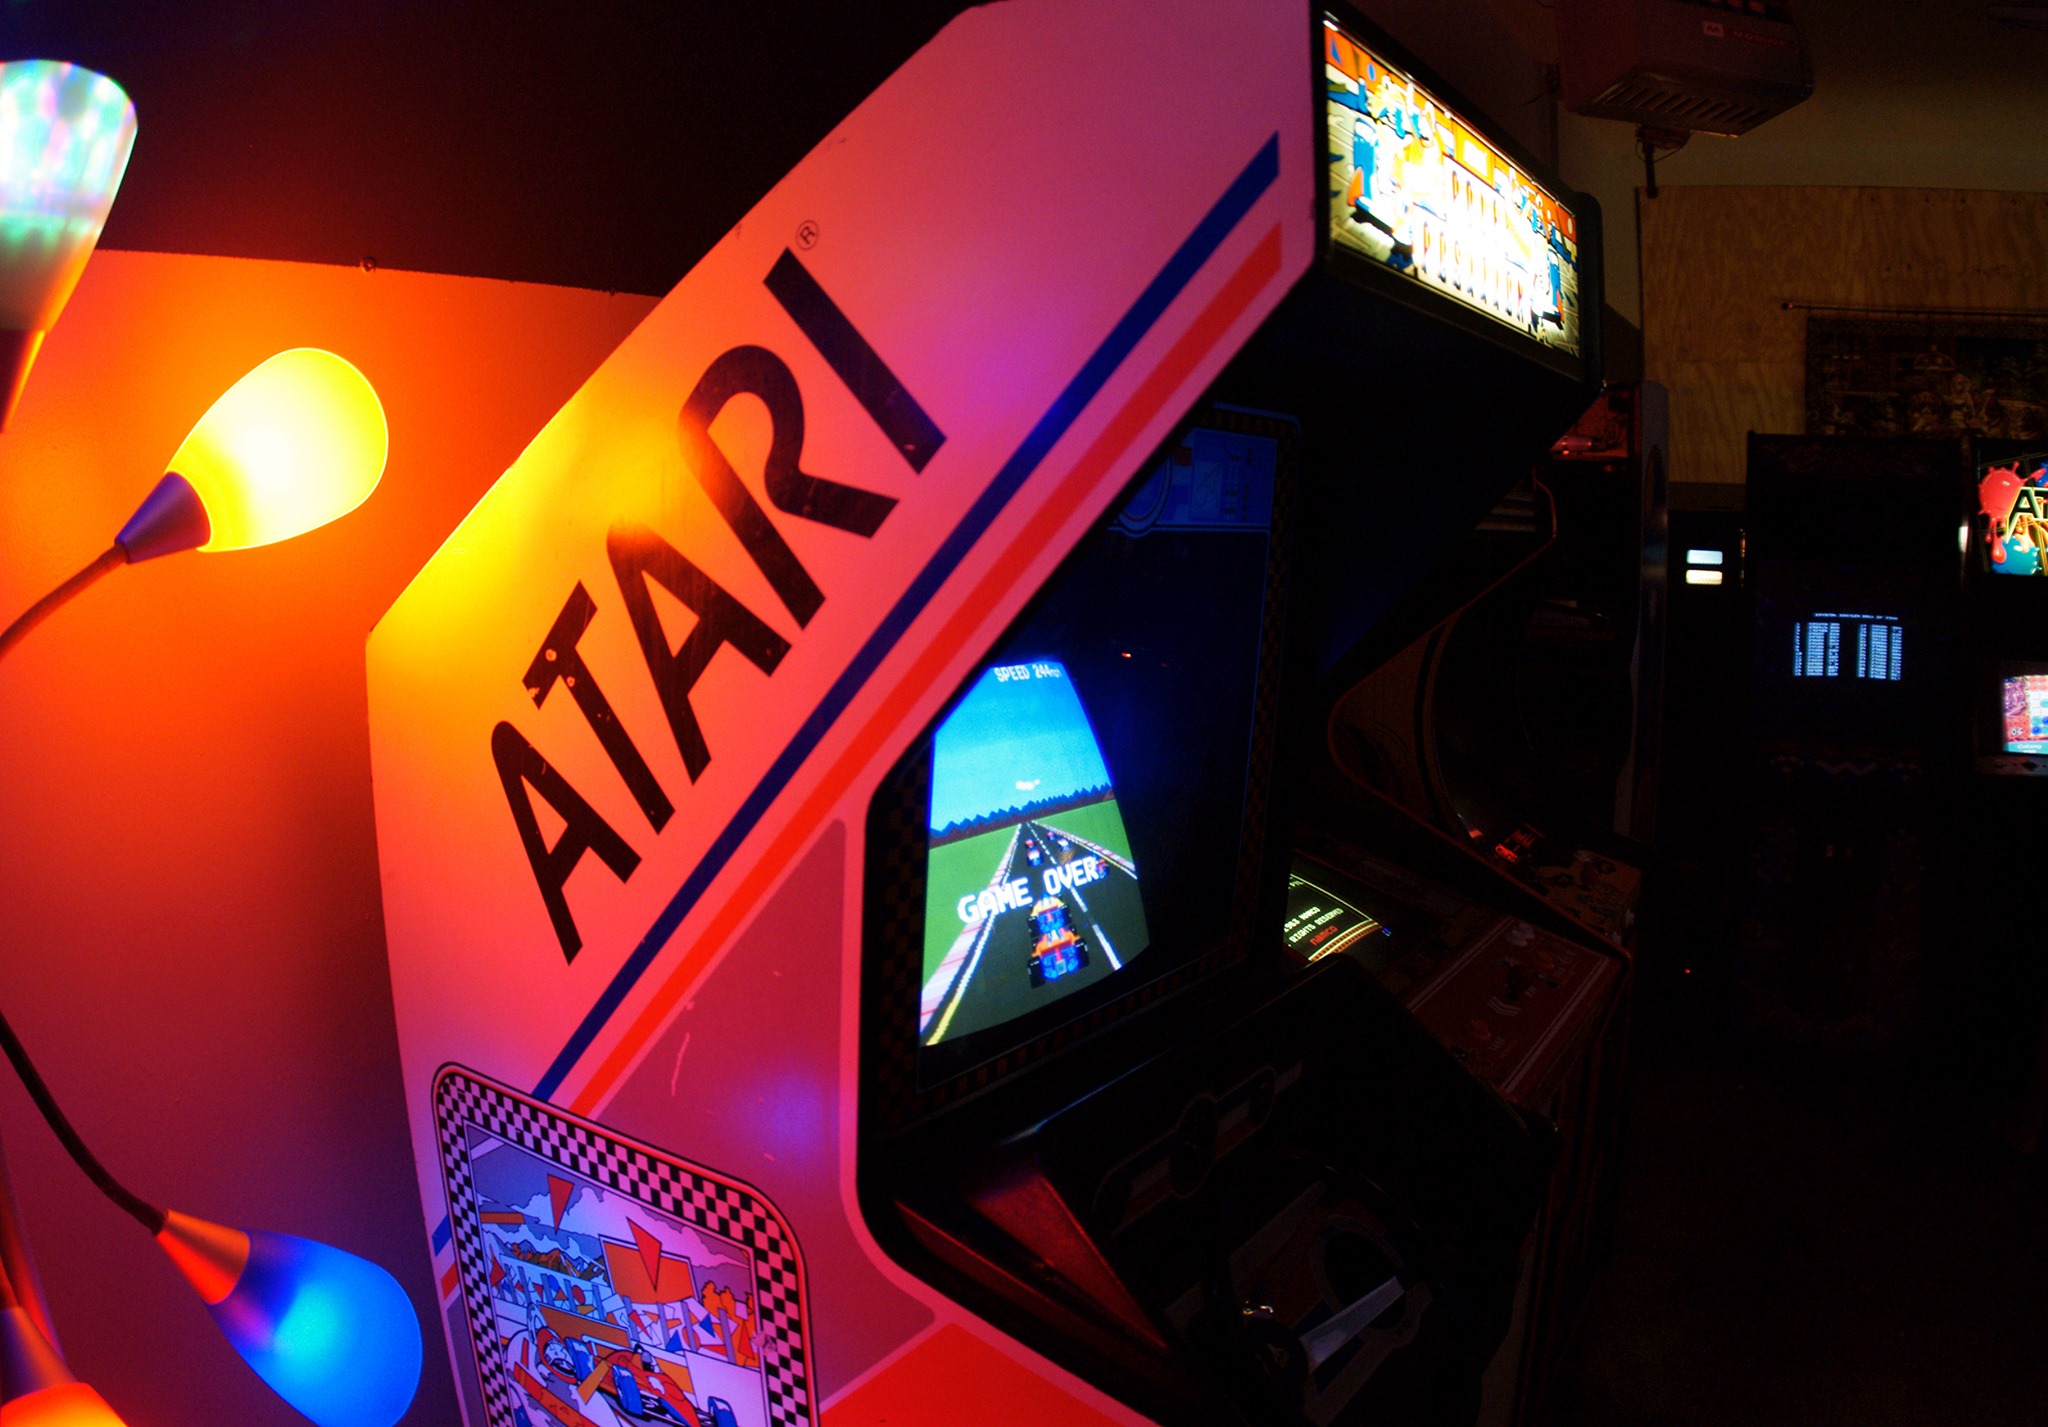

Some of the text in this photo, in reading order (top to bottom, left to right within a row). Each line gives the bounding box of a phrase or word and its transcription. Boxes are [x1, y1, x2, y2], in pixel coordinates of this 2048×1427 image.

[491, 247, 946, 966] ATARI
[993, 664, 1030, 683] SPEED
[957, 856, 1100, 925] GAME OVER
